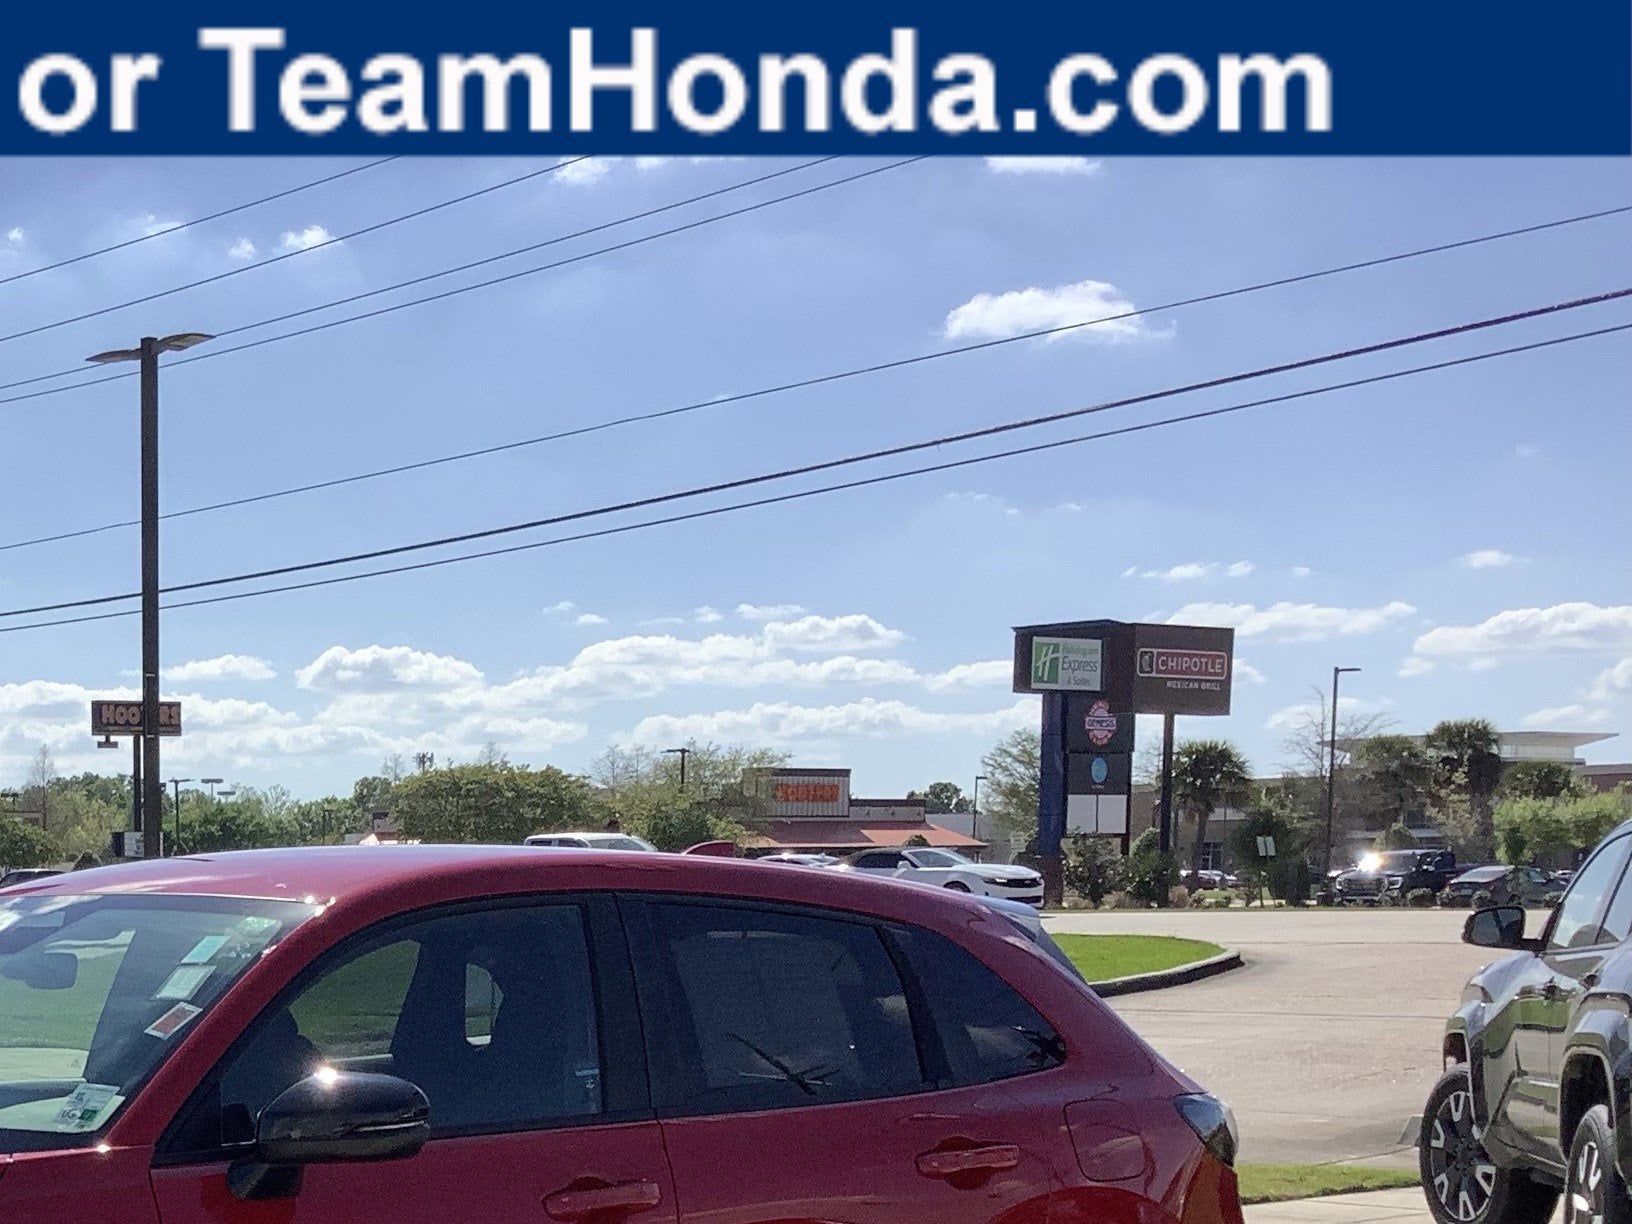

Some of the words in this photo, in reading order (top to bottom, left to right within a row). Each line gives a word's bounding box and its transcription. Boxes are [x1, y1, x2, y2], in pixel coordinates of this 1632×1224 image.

[1061, 655, 1099, 674] Express
[1158, 655, 1224, 674] CHIPOTLE
[101, 704, 181, 725] HOORS
